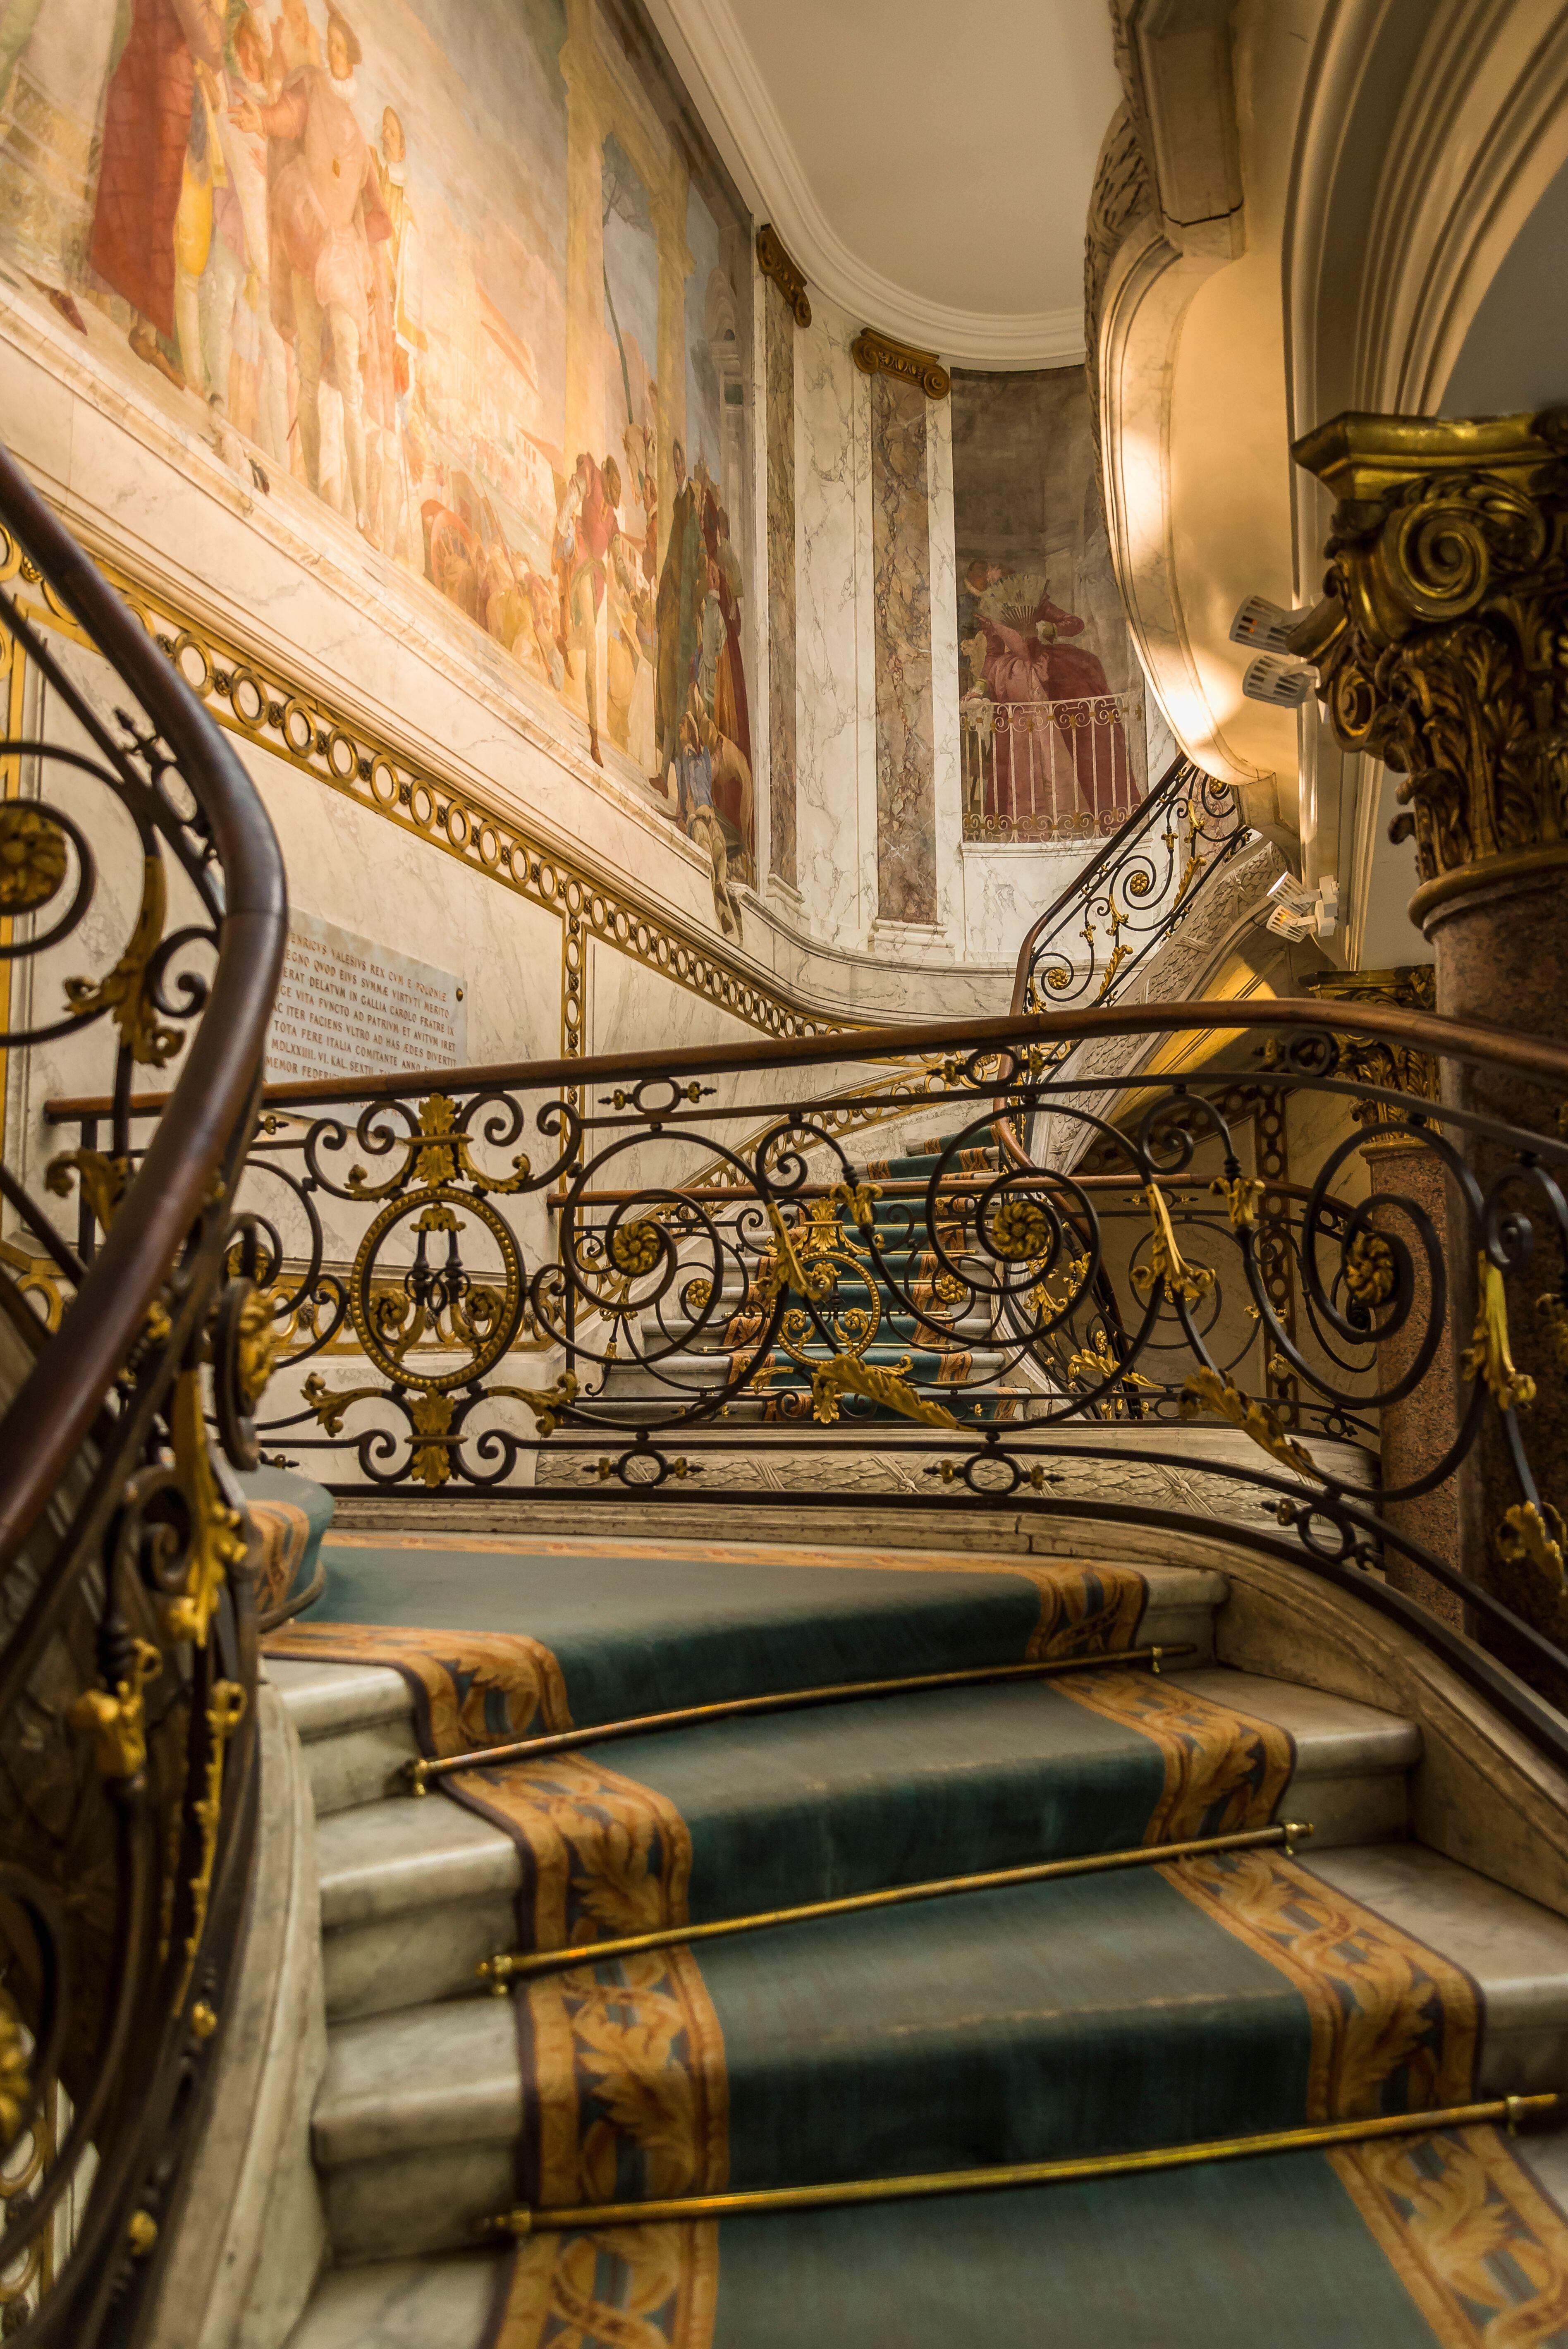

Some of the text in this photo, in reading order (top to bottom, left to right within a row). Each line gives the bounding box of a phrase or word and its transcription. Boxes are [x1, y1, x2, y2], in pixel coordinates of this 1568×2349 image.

[285, 949, 449, 1019] EGNO QVOD EIVS SVMMÆ VIRTVTI MERITO
[287, 932, 327, 955] ENRICVS
[331, 948, 366, 971] VALESIVS
[370, 964, 385, 978] REX
[389, 972, 404, 986] CVM
[407, 978, 411, 988] E
[280, 985, 456, 1052] GE VITA FVNCTO AD PATRIVM ET AVITVM IRET
[283, 966, 454, 1036] ERAT DELATVM IN GALLIA CAROLO FRATRE IX
[273, 1002, 457, 1068] AC ITER FACIENS VLTRO AD HAS ÆDES DIVERTIT
[274, 1020, 421, 1072] TOTA FERE ITALIA COMITANTE ANNO
[318, 1051, 329, 1064] VI.
[265, 1056, 345, 1079] MEMOR FEDERI
